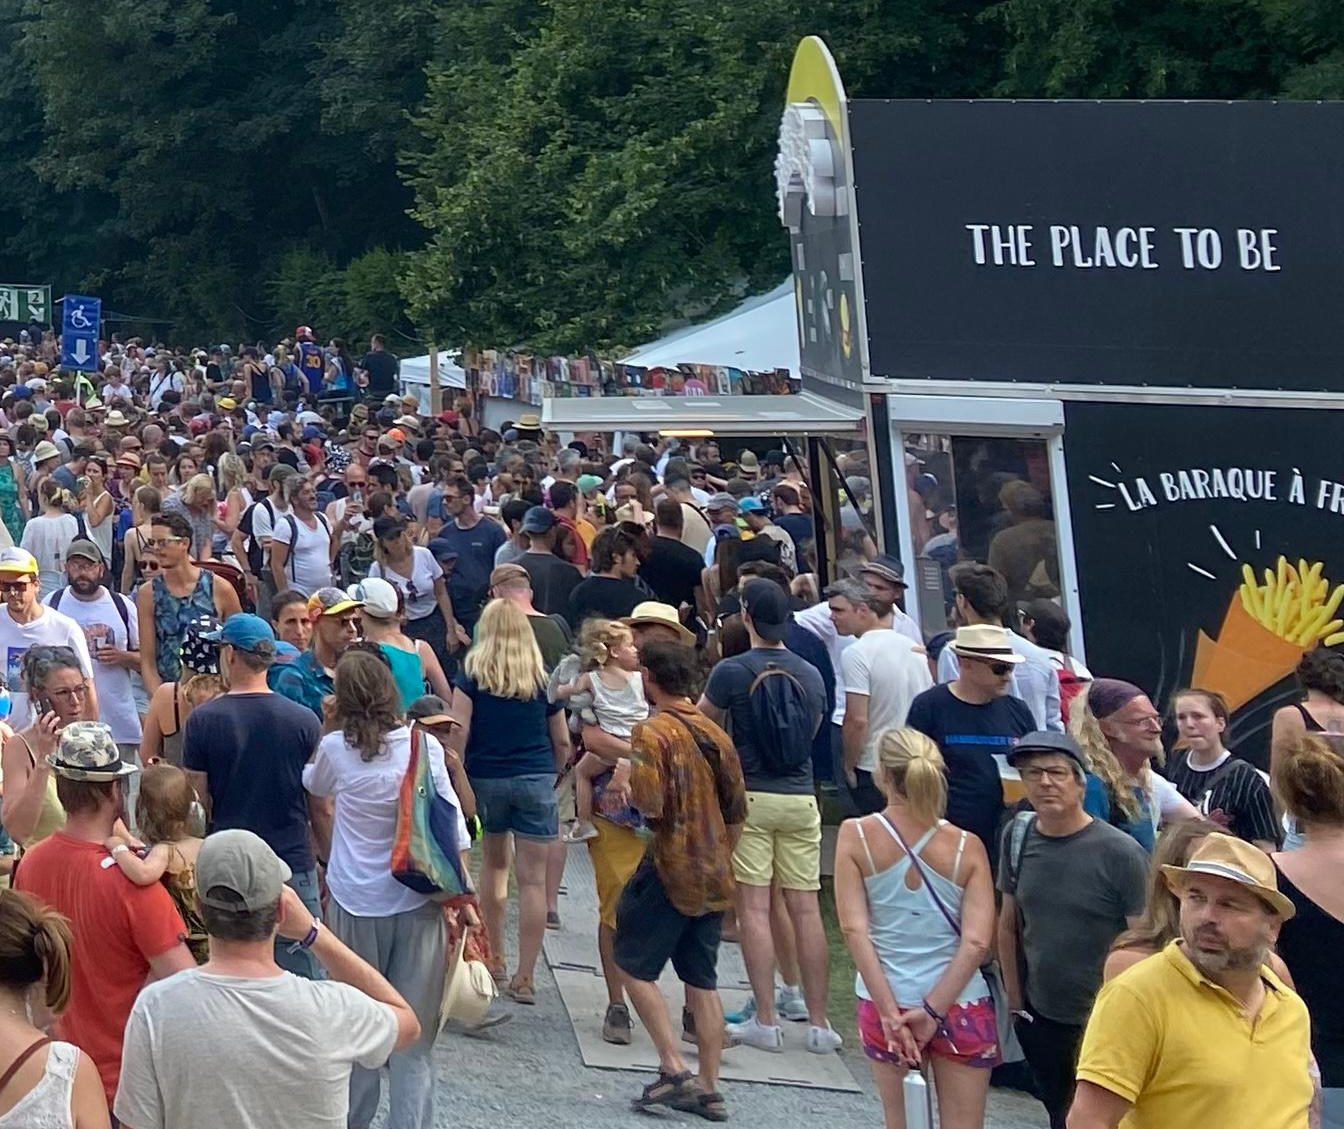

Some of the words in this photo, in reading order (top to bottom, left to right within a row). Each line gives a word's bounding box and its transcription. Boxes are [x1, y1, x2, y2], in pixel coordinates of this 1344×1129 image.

[965, 223, 1036, 267] THE
[1049, 224, 1159, 269] PLACE
[1173, 227, 1223, 270] TO
[1236, 228, 1282, 272] BE
[32, 292, 40, 303] 2
[306, 354, 321, 369] 30
[1118, 477, 1158, 512] LA
[1159, 467, 1277, 503] BARAQUE
[1288, 467, 1306, 505] À
